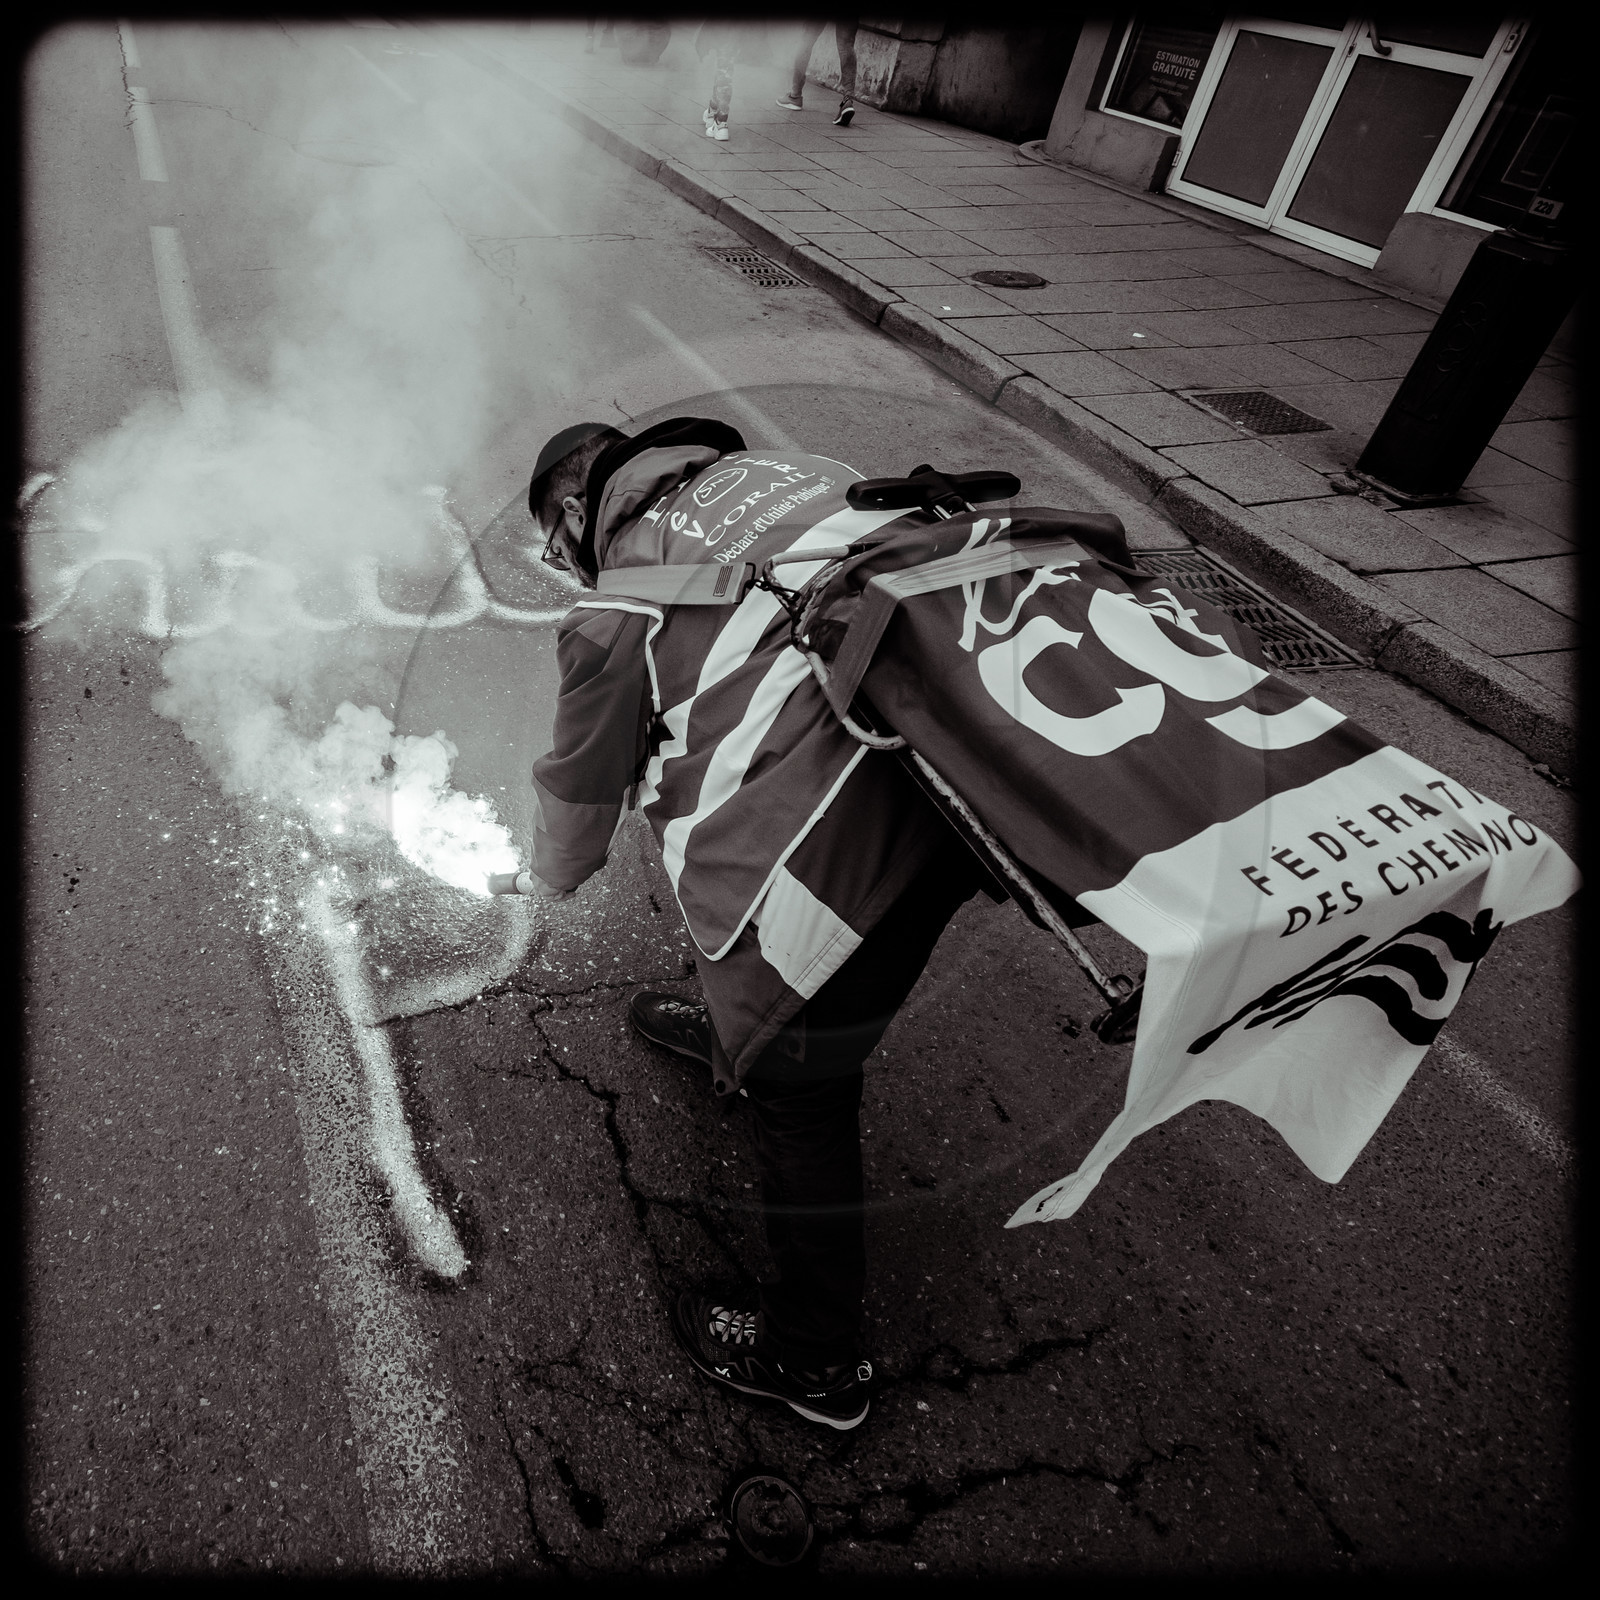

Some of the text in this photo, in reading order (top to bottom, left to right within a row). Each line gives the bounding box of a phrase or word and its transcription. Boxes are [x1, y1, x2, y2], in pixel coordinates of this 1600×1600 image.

[1152, 61, 1197, 80] GRATUITE
[1156, 51, 1200, 68] ESTIMATION
[1534, 200, 1554, 215] 228
[704, 471, 816, 547] CORAIL
[713, 528, 759, 564] Déclaré
[752, 499, 796, 533] d'Utilité
[786, 482, 830, 505] Publique
[1240, 780, 1484, 896] FÉDÉRATI
[1279, 881, 1363, 938] DES
